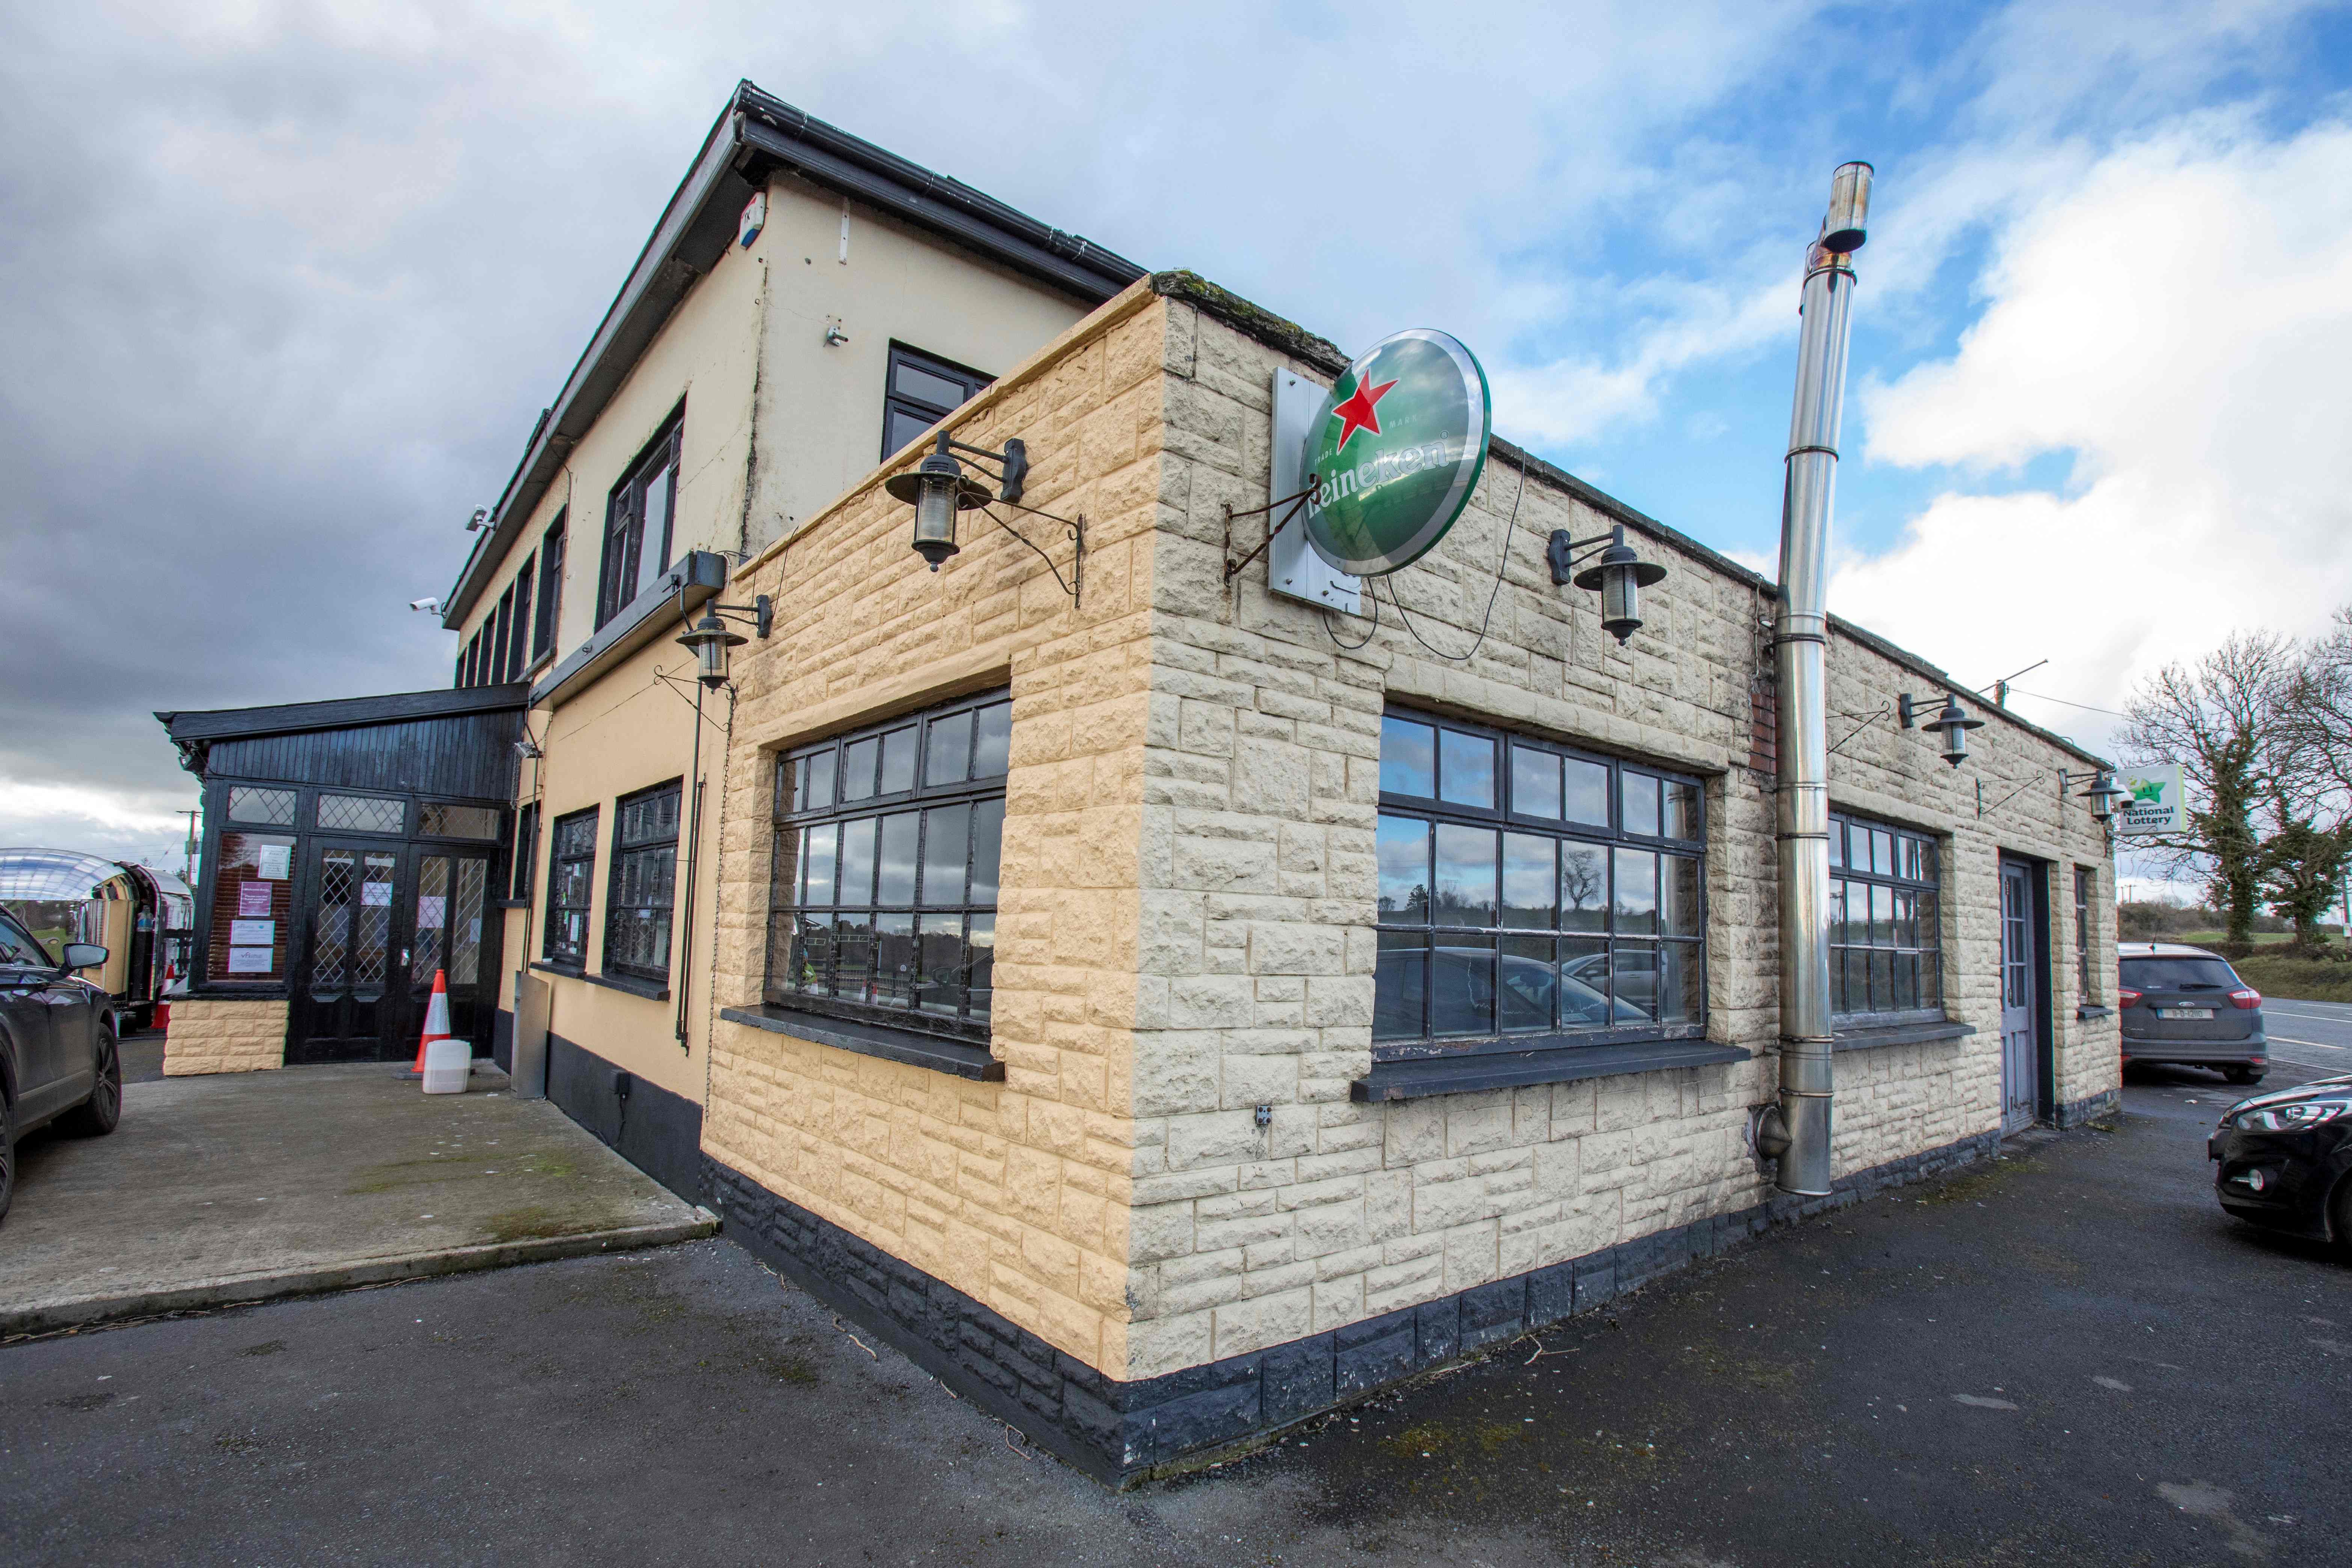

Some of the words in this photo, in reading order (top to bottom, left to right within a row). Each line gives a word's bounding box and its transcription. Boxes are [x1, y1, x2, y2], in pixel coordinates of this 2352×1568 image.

[1315, 447, 1332, 466] TRADE
[1389, 414, 1417, 429] MARK
[2123, 806, 2174, 817] National
[2127, 816, 2171, 825] Lottery
